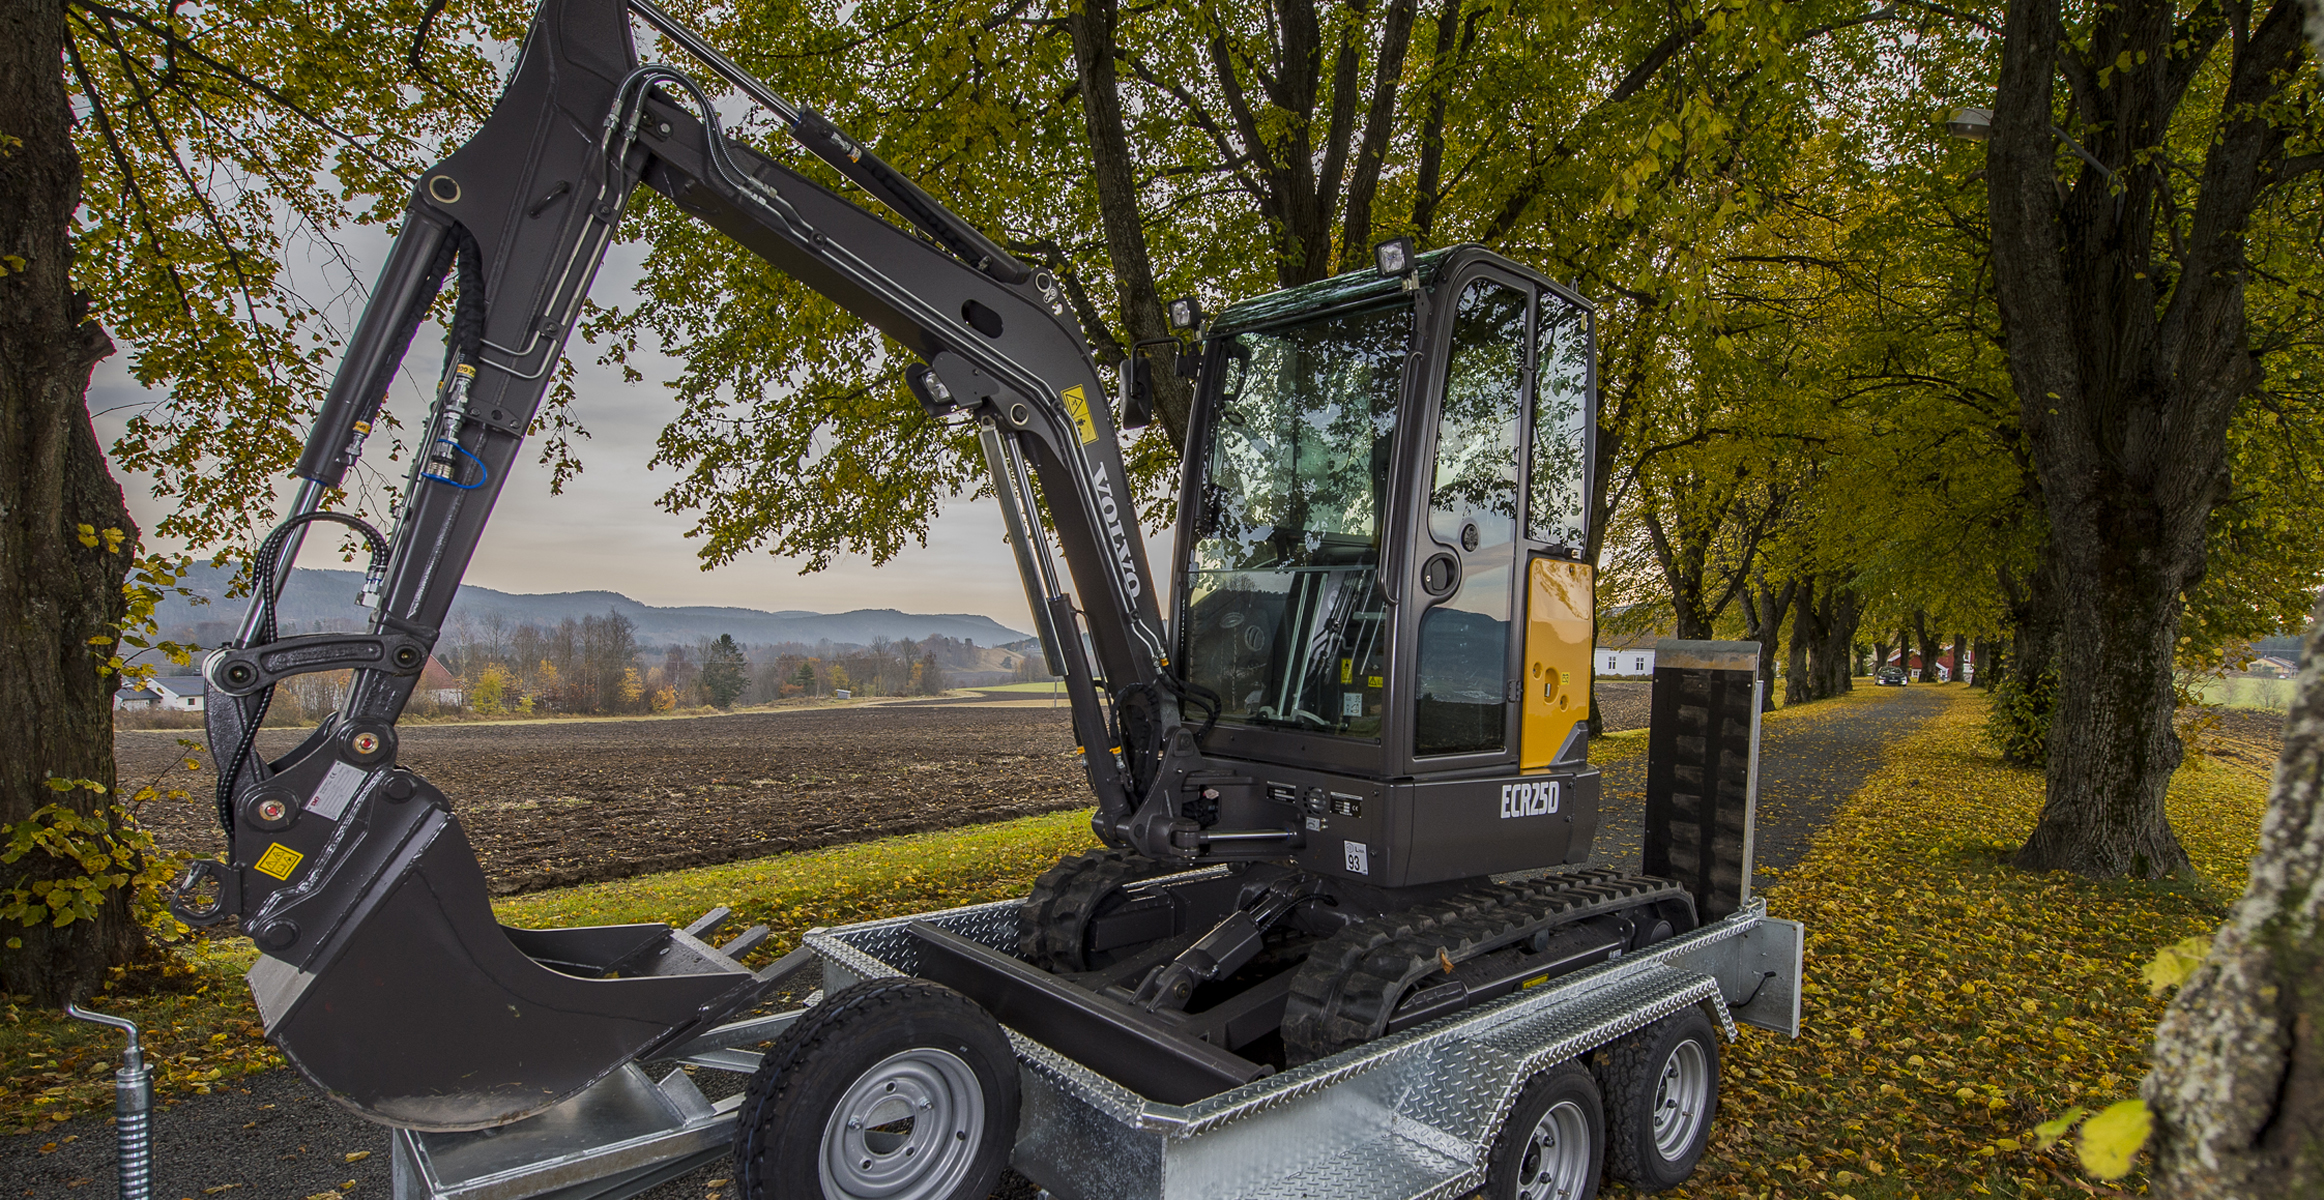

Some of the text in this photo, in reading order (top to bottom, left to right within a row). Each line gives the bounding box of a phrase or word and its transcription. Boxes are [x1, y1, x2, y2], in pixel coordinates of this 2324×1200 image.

[1093, 461, 1141, 598] VOLVO
[1500, 780, 1560, 819] ECR25D
[1348, 854, 1360, 871] 93
